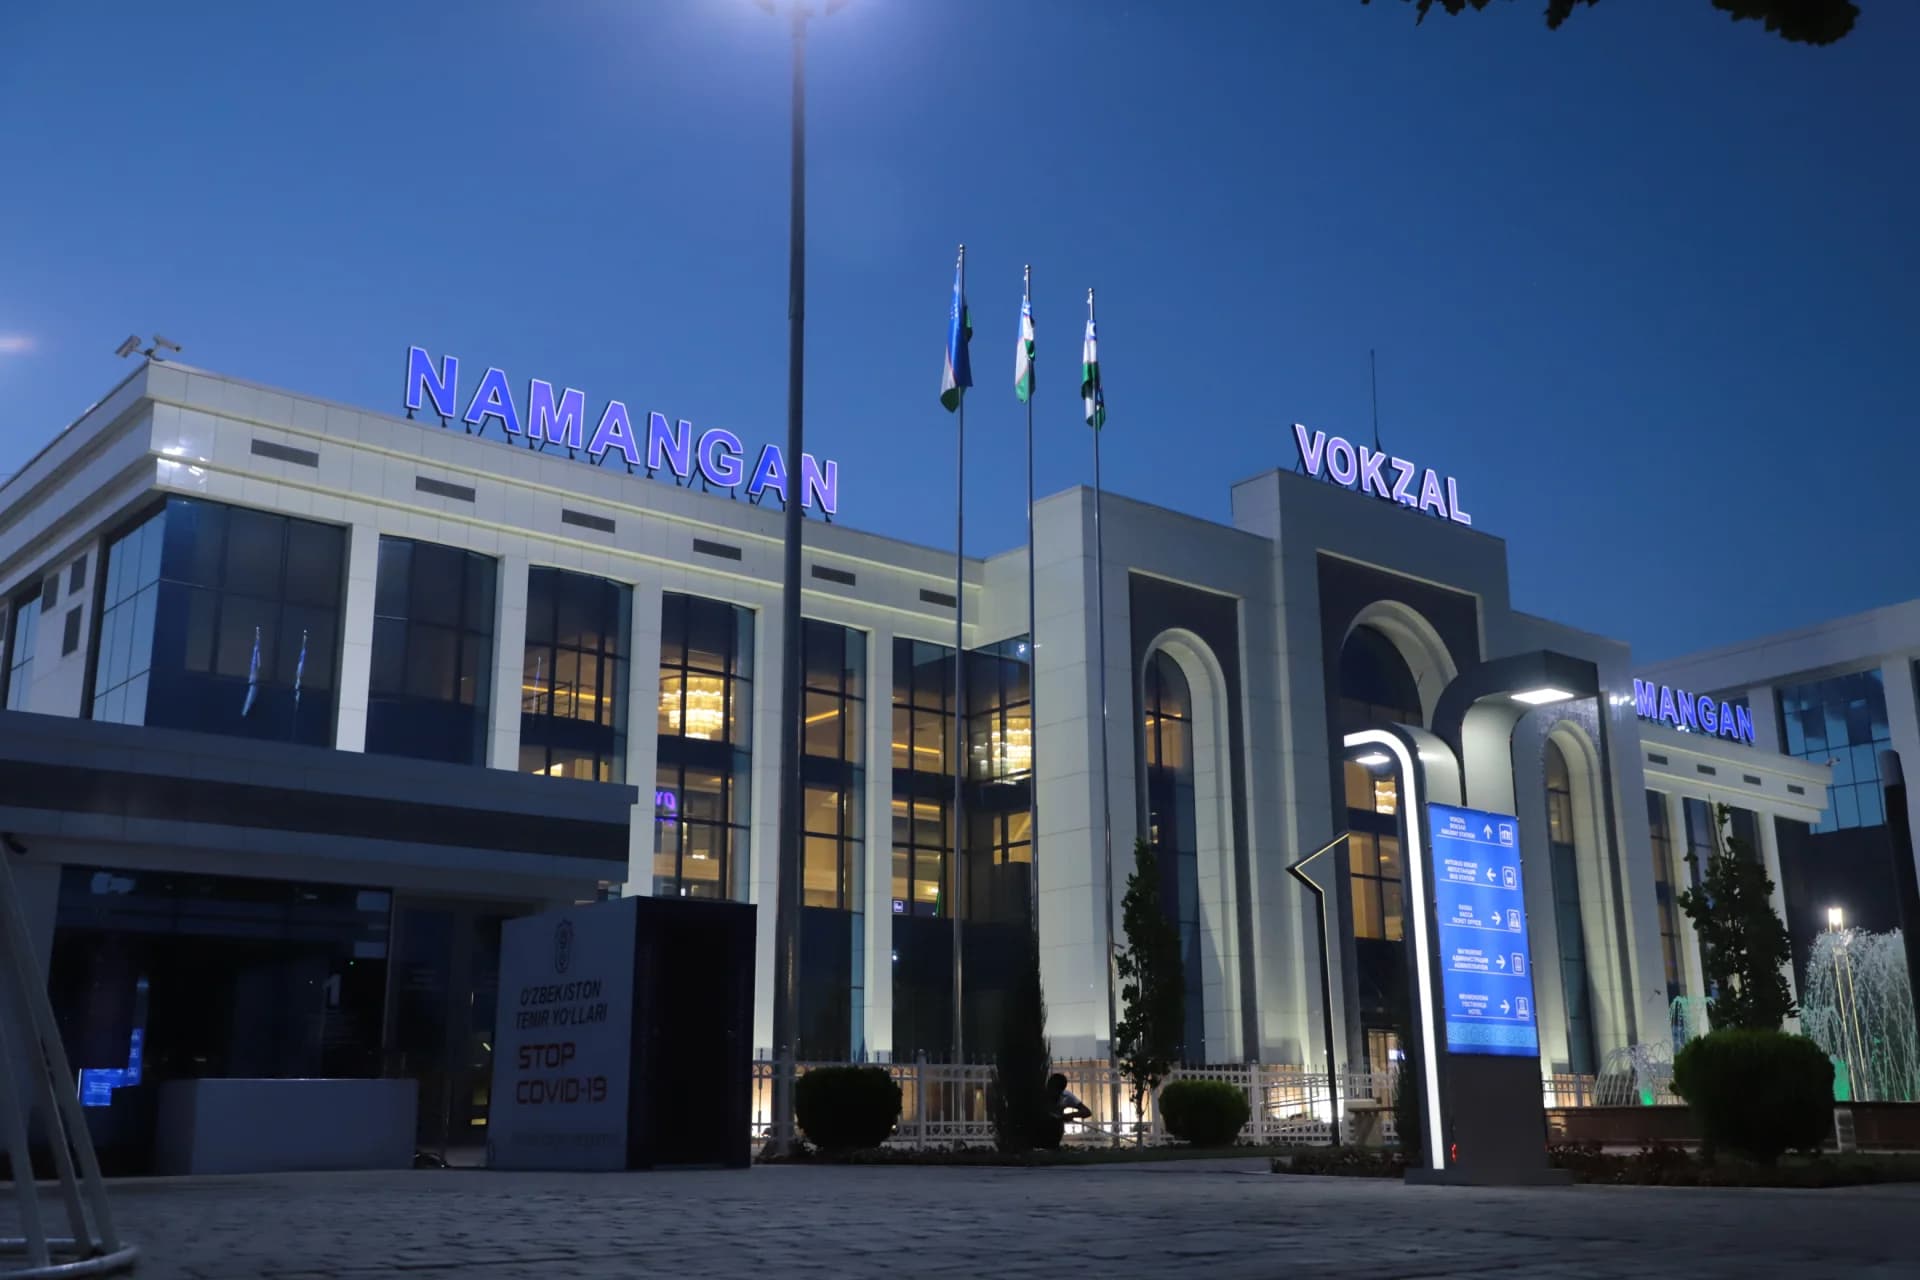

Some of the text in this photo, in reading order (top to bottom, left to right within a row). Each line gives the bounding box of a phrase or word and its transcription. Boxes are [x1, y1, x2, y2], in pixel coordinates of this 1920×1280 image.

[406, 345, 838, 514] NAMANGAN
[1294, 423, 1472, 525] VOKZAL
[518, 1042, 576, 1070] STOP
[516, 1075, 608, 1104] COVID-19
